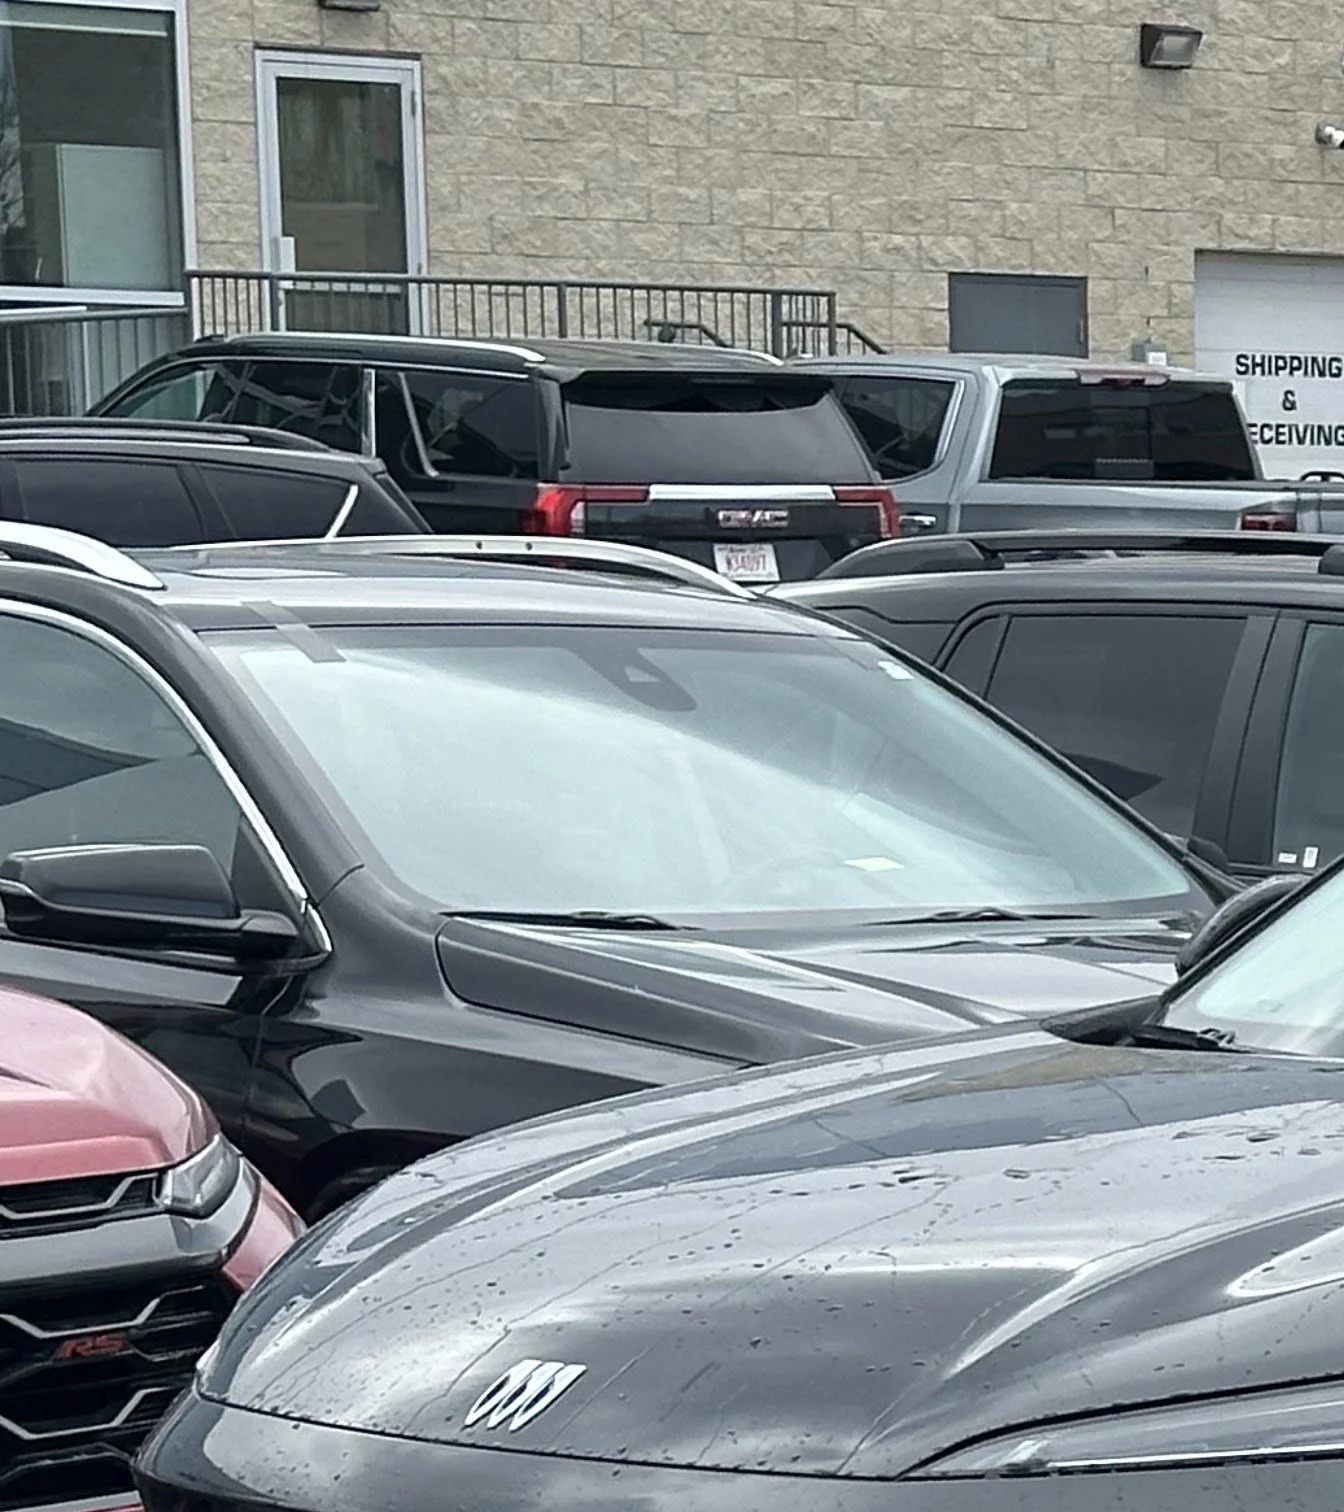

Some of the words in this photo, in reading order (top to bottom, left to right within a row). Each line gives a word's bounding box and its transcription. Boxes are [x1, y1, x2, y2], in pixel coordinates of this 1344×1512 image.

[1235, 353, 1343, 378] SHIPPING
[1282, 389, 1297, 411] &
[62, 1335, 125, 1359] RS
